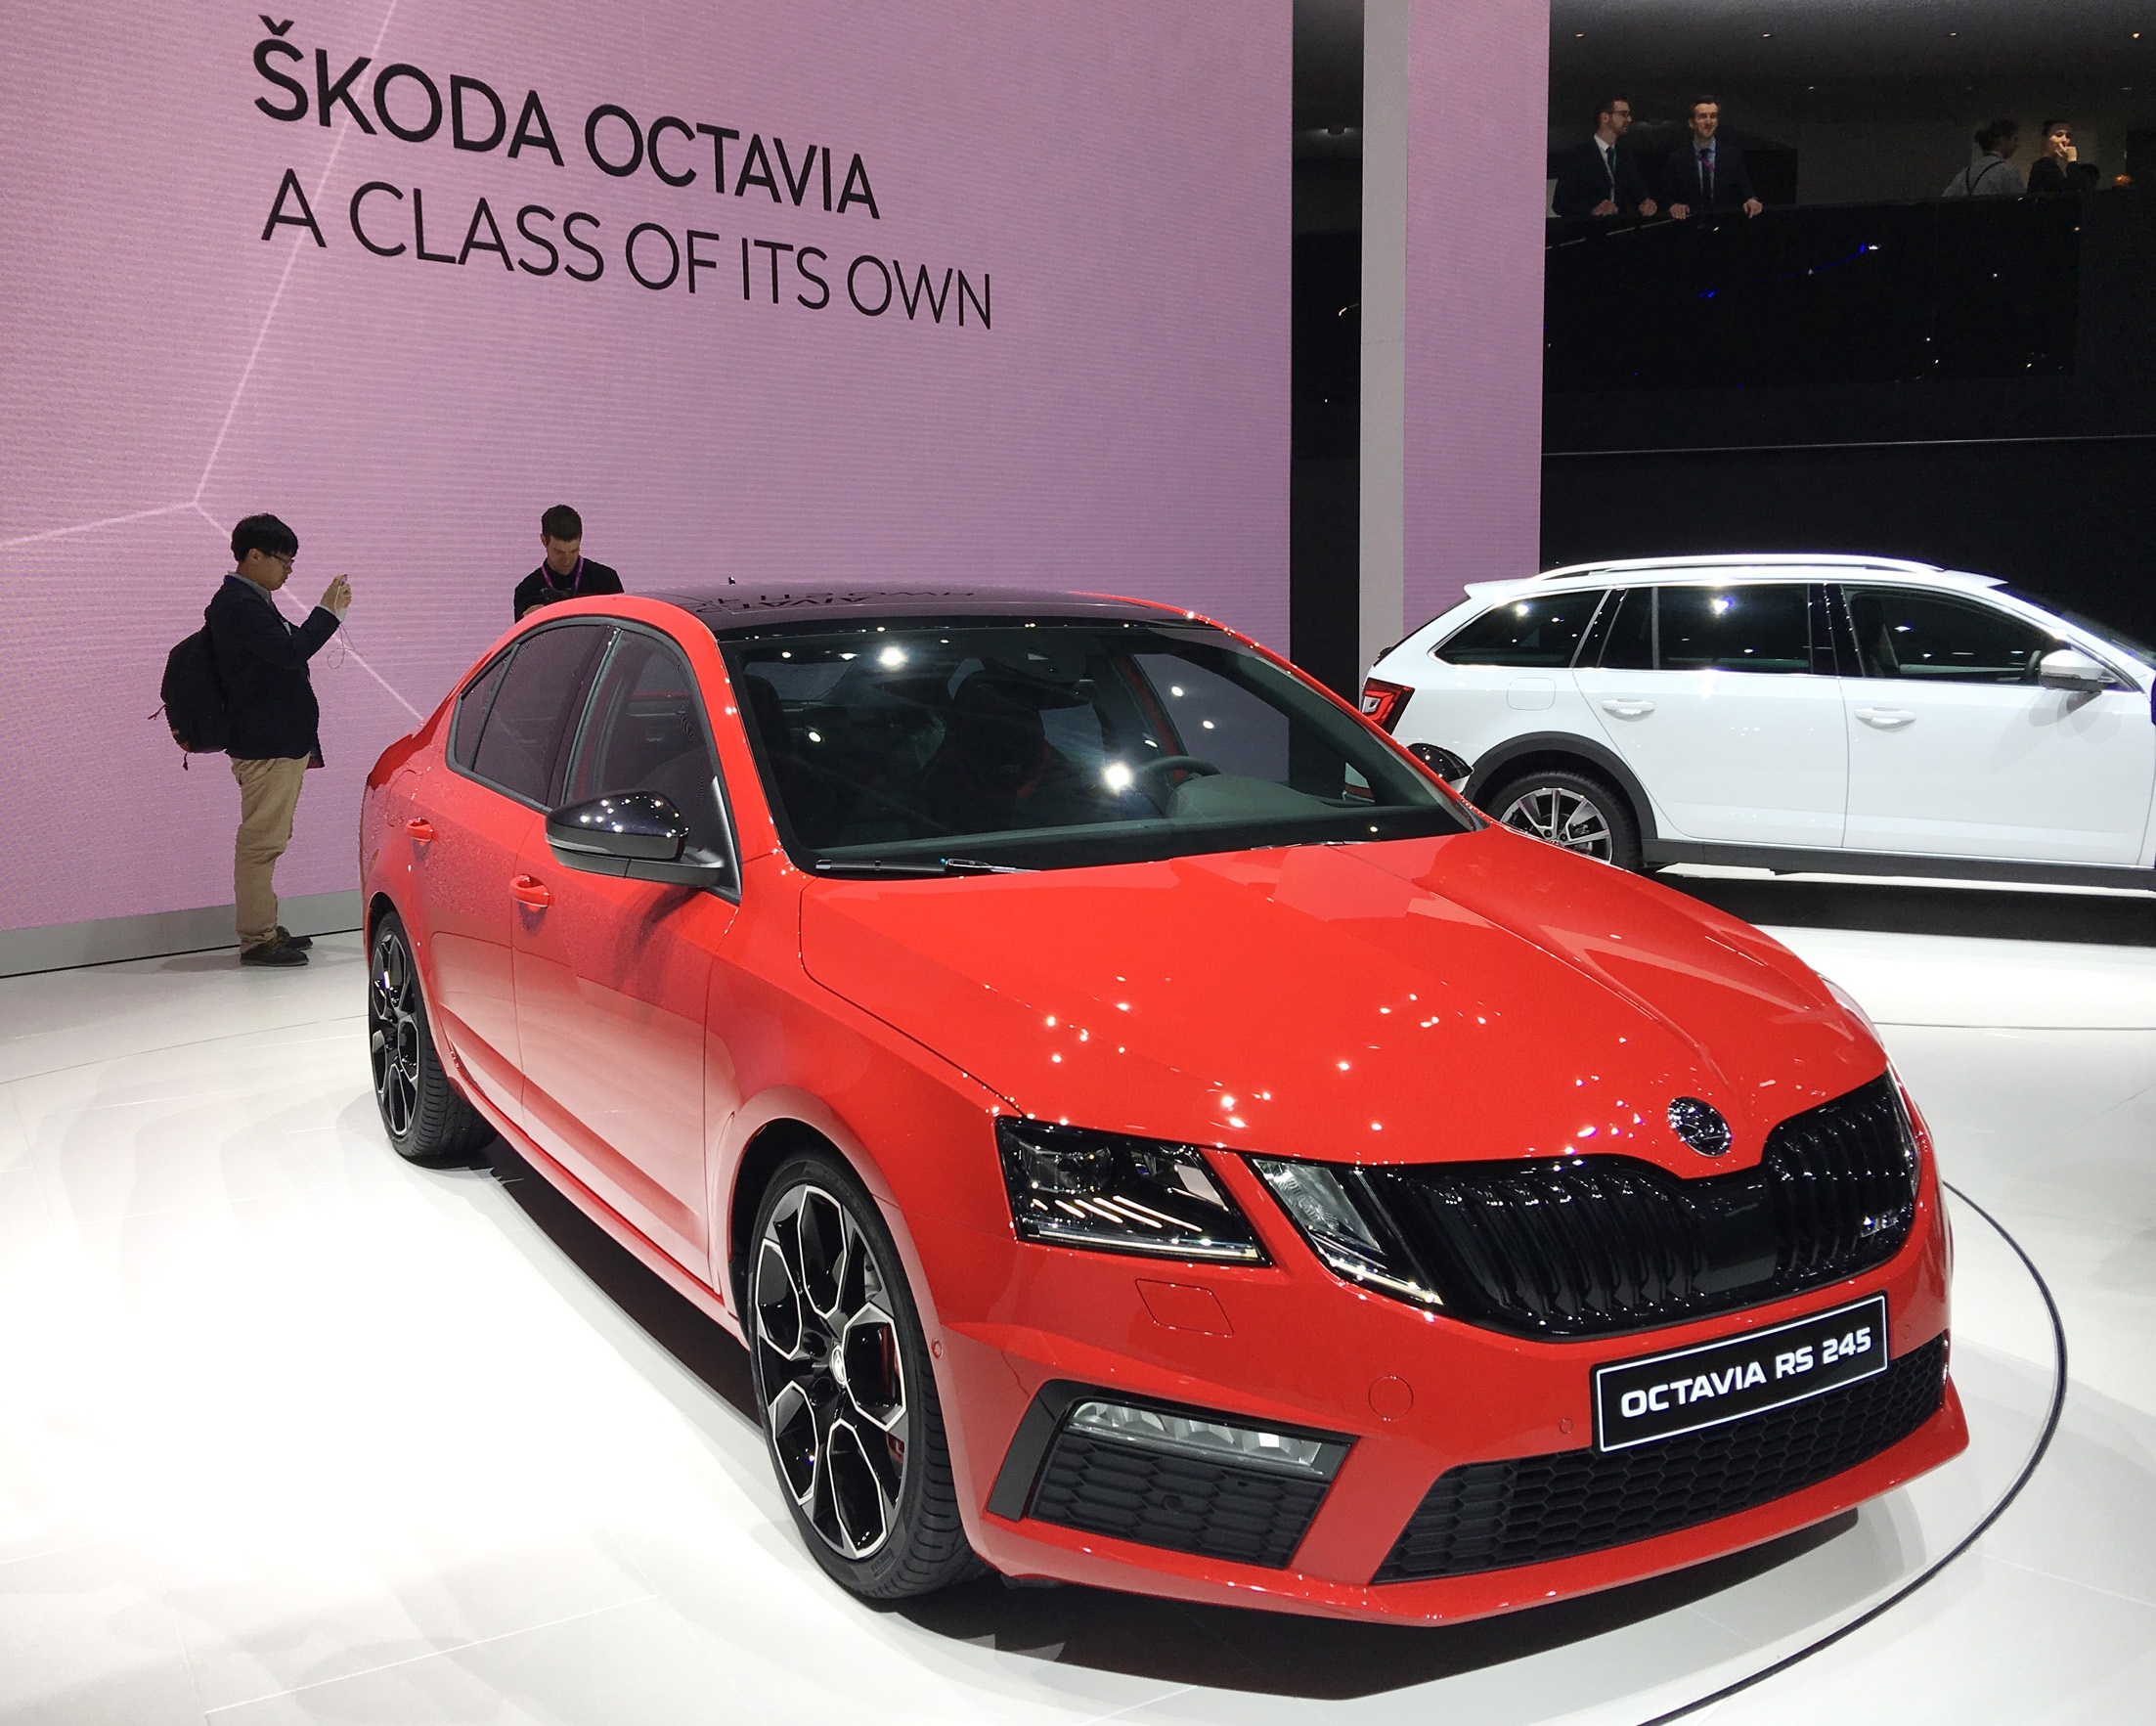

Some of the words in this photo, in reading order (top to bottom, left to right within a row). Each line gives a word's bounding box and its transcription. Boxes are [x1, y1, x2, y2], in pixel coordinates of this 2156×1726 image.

[252, 14, 565, 167] ŠKODA
[584, 103, 881, 220] OCTAVIA
[260, 167, 328, 248] A
[349, 181, 605, 283] CLASS
[625, 222, 721, 294] OF
[741, 237, 830, 310] ITS
[847, 254, 991, 331] OWN
[1620, 1361, 1767, 1418] OCTAVIA
[1775, 1346, 1814, 1380] RS
[1822, 1326, 1871, 1364] 245
